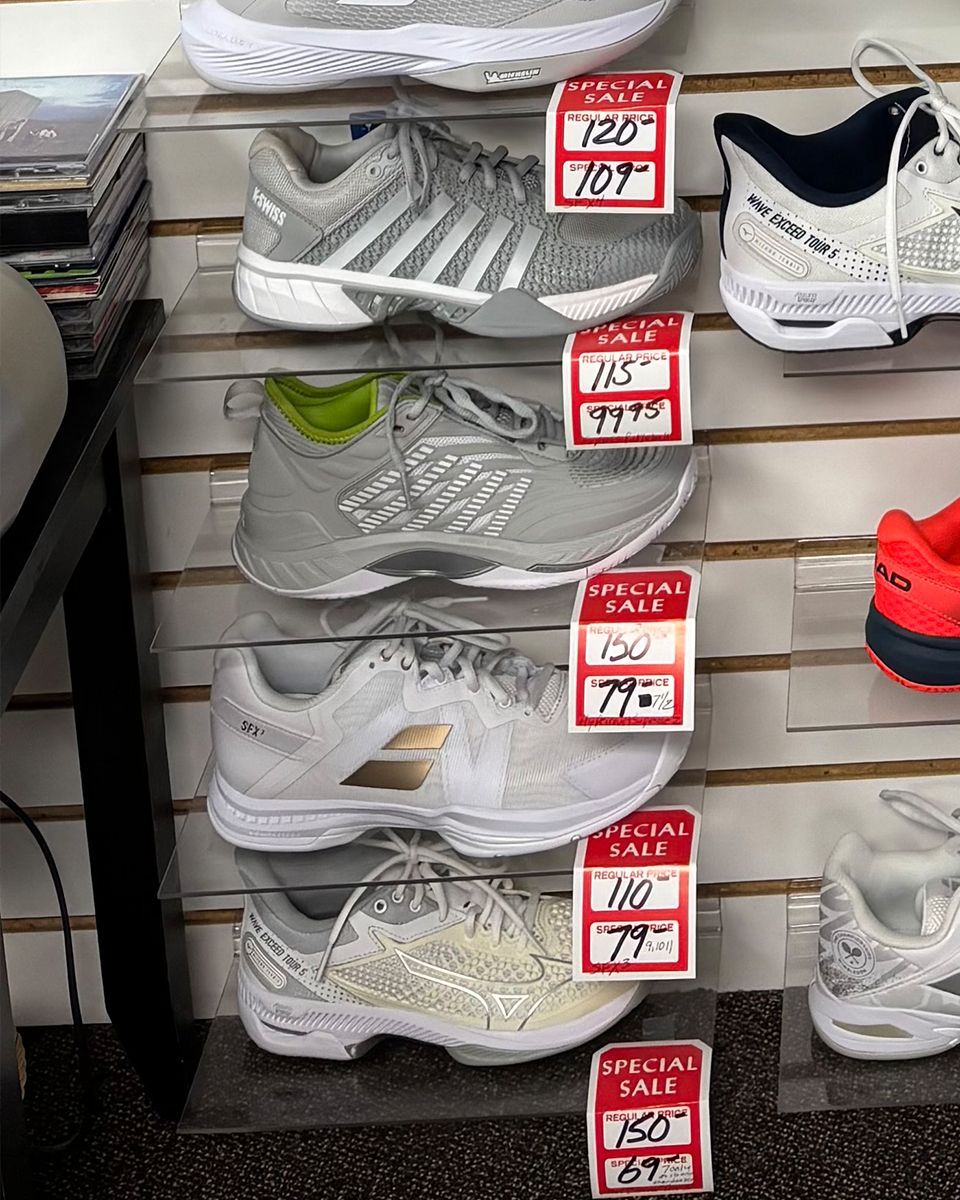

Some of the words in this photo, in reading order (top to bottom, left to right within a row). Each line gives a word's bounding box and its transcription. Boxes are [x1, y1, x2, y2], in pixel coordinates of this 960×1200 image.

[567, 80, 668, 91] SPECIAL
[584, 91, 645, 104] SALE
[567, 113, 619, 121] REGULAR
[746, 193, 773, 218] WAVE
[769, 213, 806, 240] EXCEED
[803, 234, 831, 256] TOUR
[828, 248, 839, 259] 5
[598, 330, 658, 344] SALE
[582, 354, 633, 363] REGULAR
[636, 352, 667, 361] PRICE
[588, 581, 686, 597] SPECIAL
[605, 598, 665, 614] SALE
[609, 841, 668, 857] SALE
[594, 871, 643, 879] REGULAR
[249, 913, 263, 934] WAVE
[260, 932, 285, 956] EXCEED
[282, 954, 302, 971] TOUR
[602, 1056, 698, 1076] SPECIAL
[619, 1077, 678, 1098] SALE
